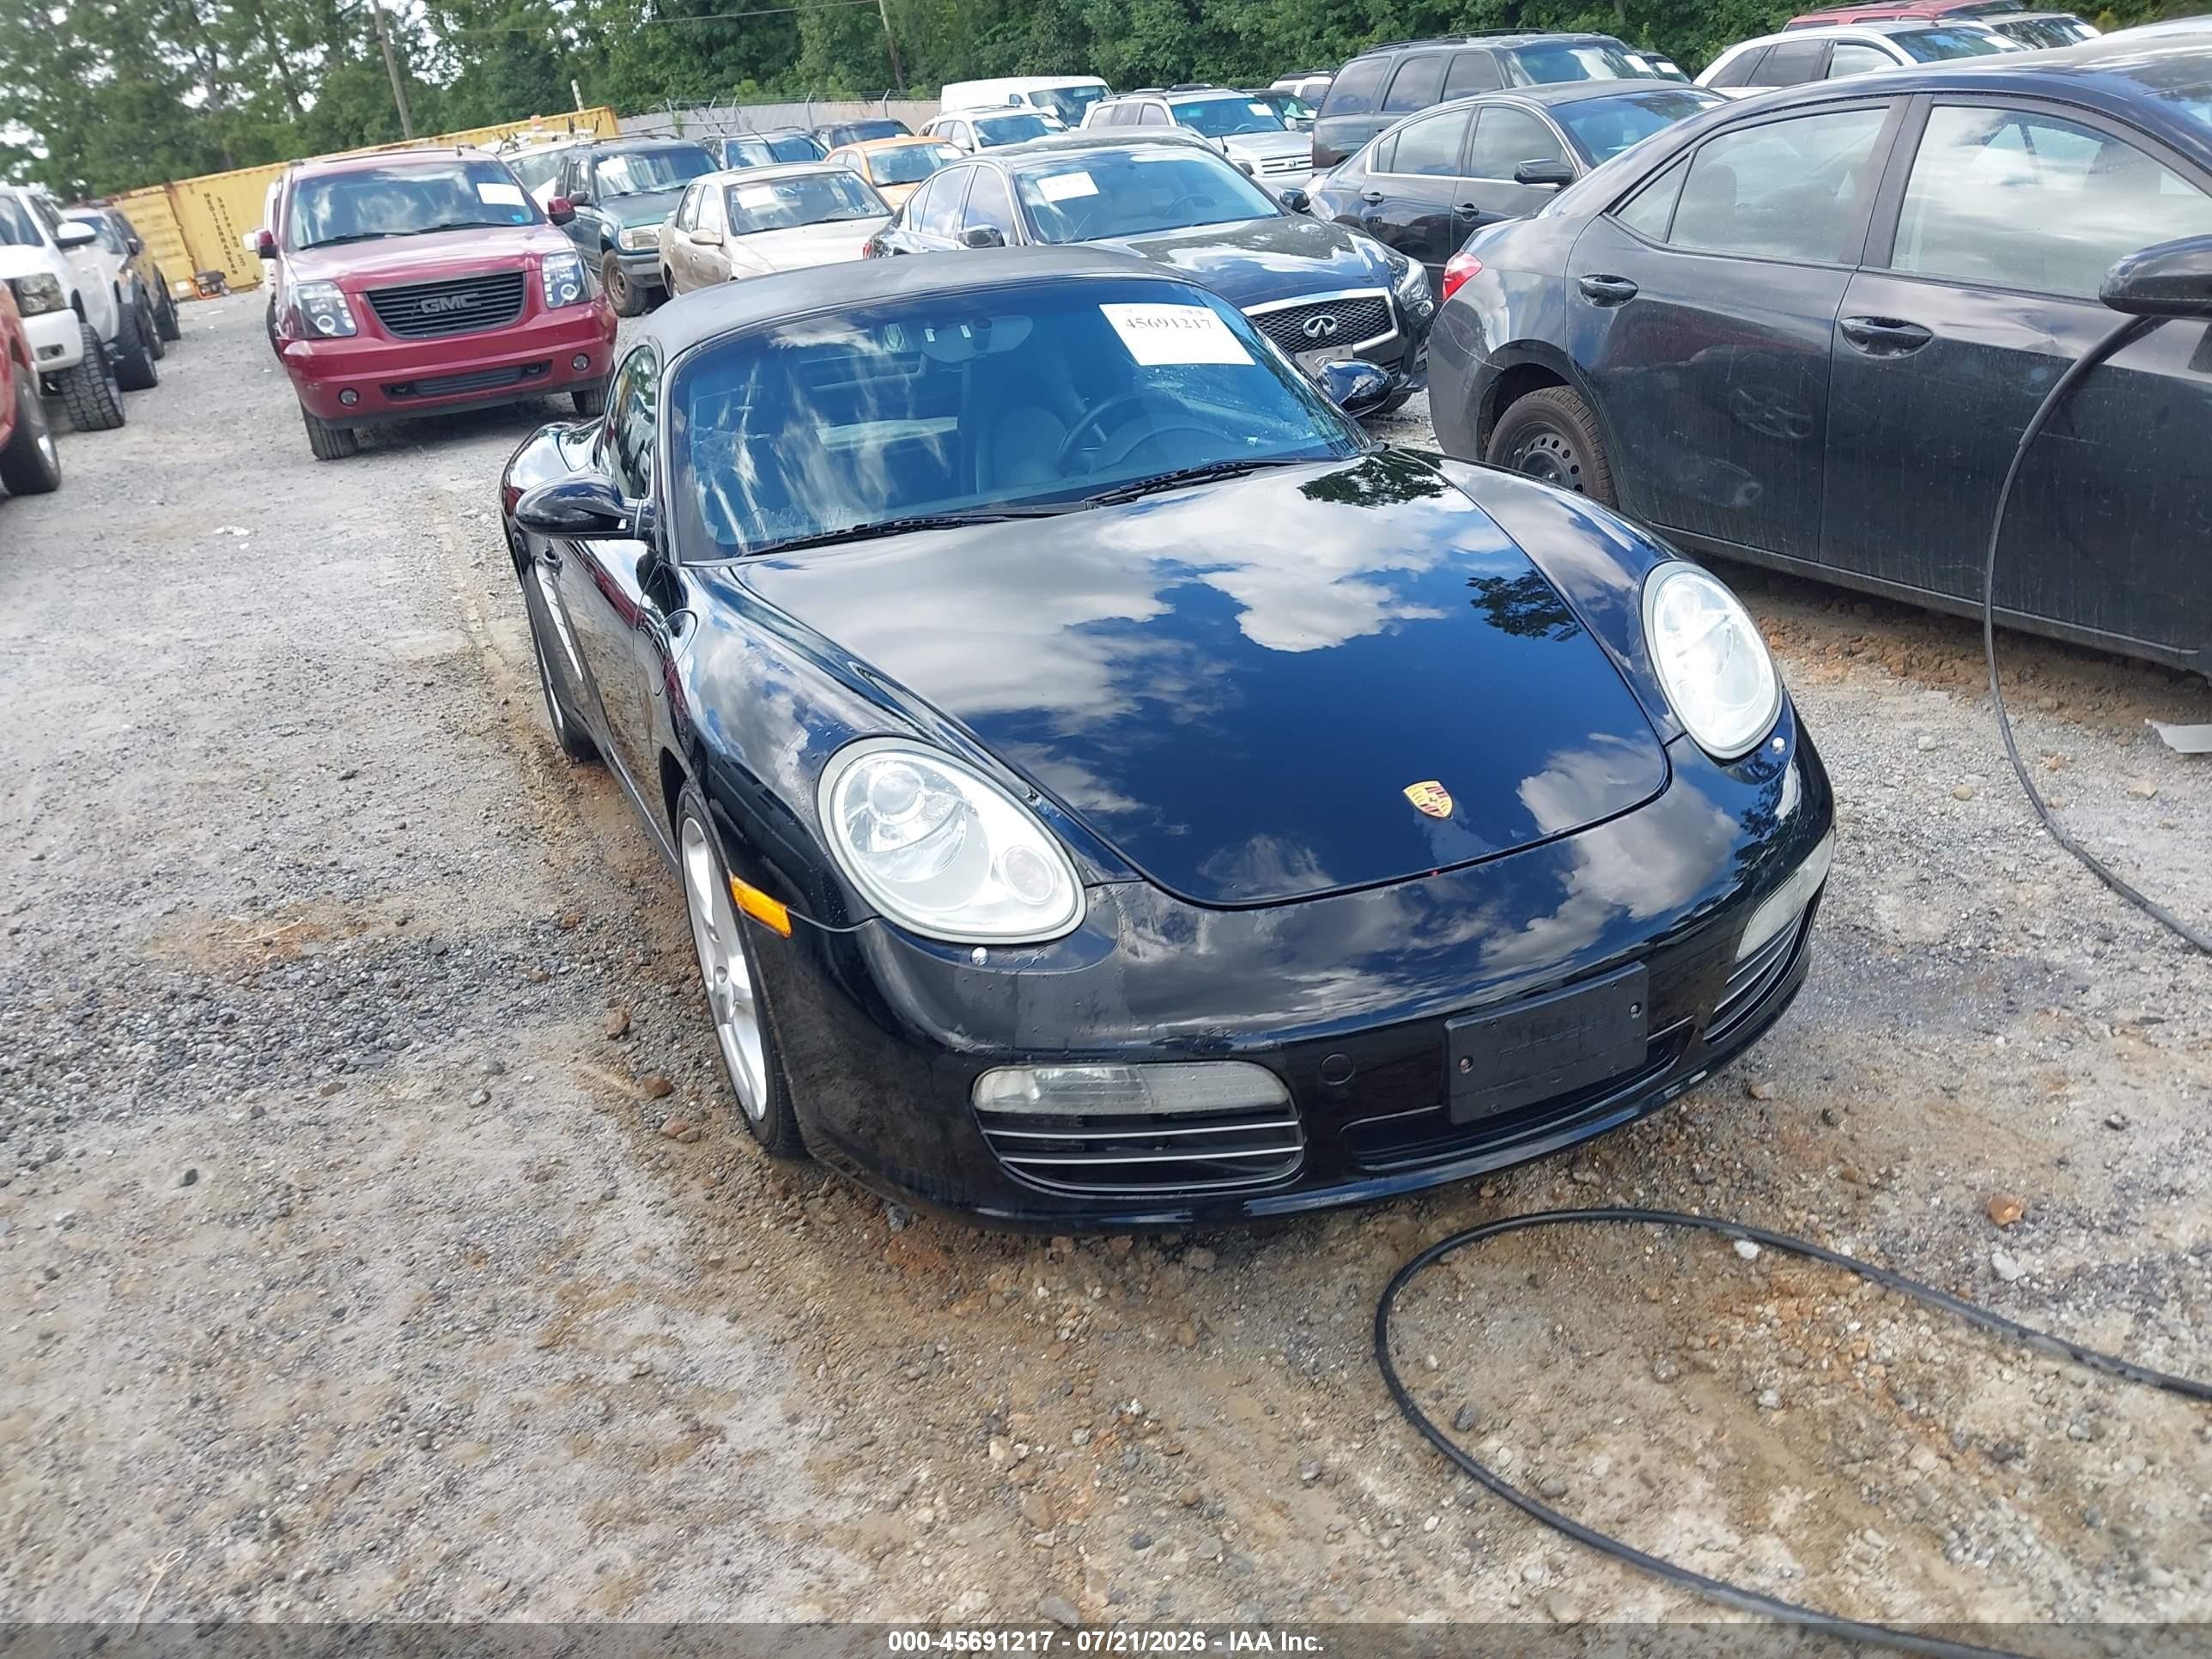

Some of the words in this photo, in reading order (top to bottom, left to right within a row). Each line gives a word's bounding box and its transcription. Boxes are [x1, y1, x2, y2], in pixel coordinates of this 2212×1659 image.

[204, 192, 238, 275] MEDITERRANEAN
[216, 197, 240, 247] SHIPPING
[421, 293, 481, 313] GMC
[1125, 318, 1212, 329] 45691217
